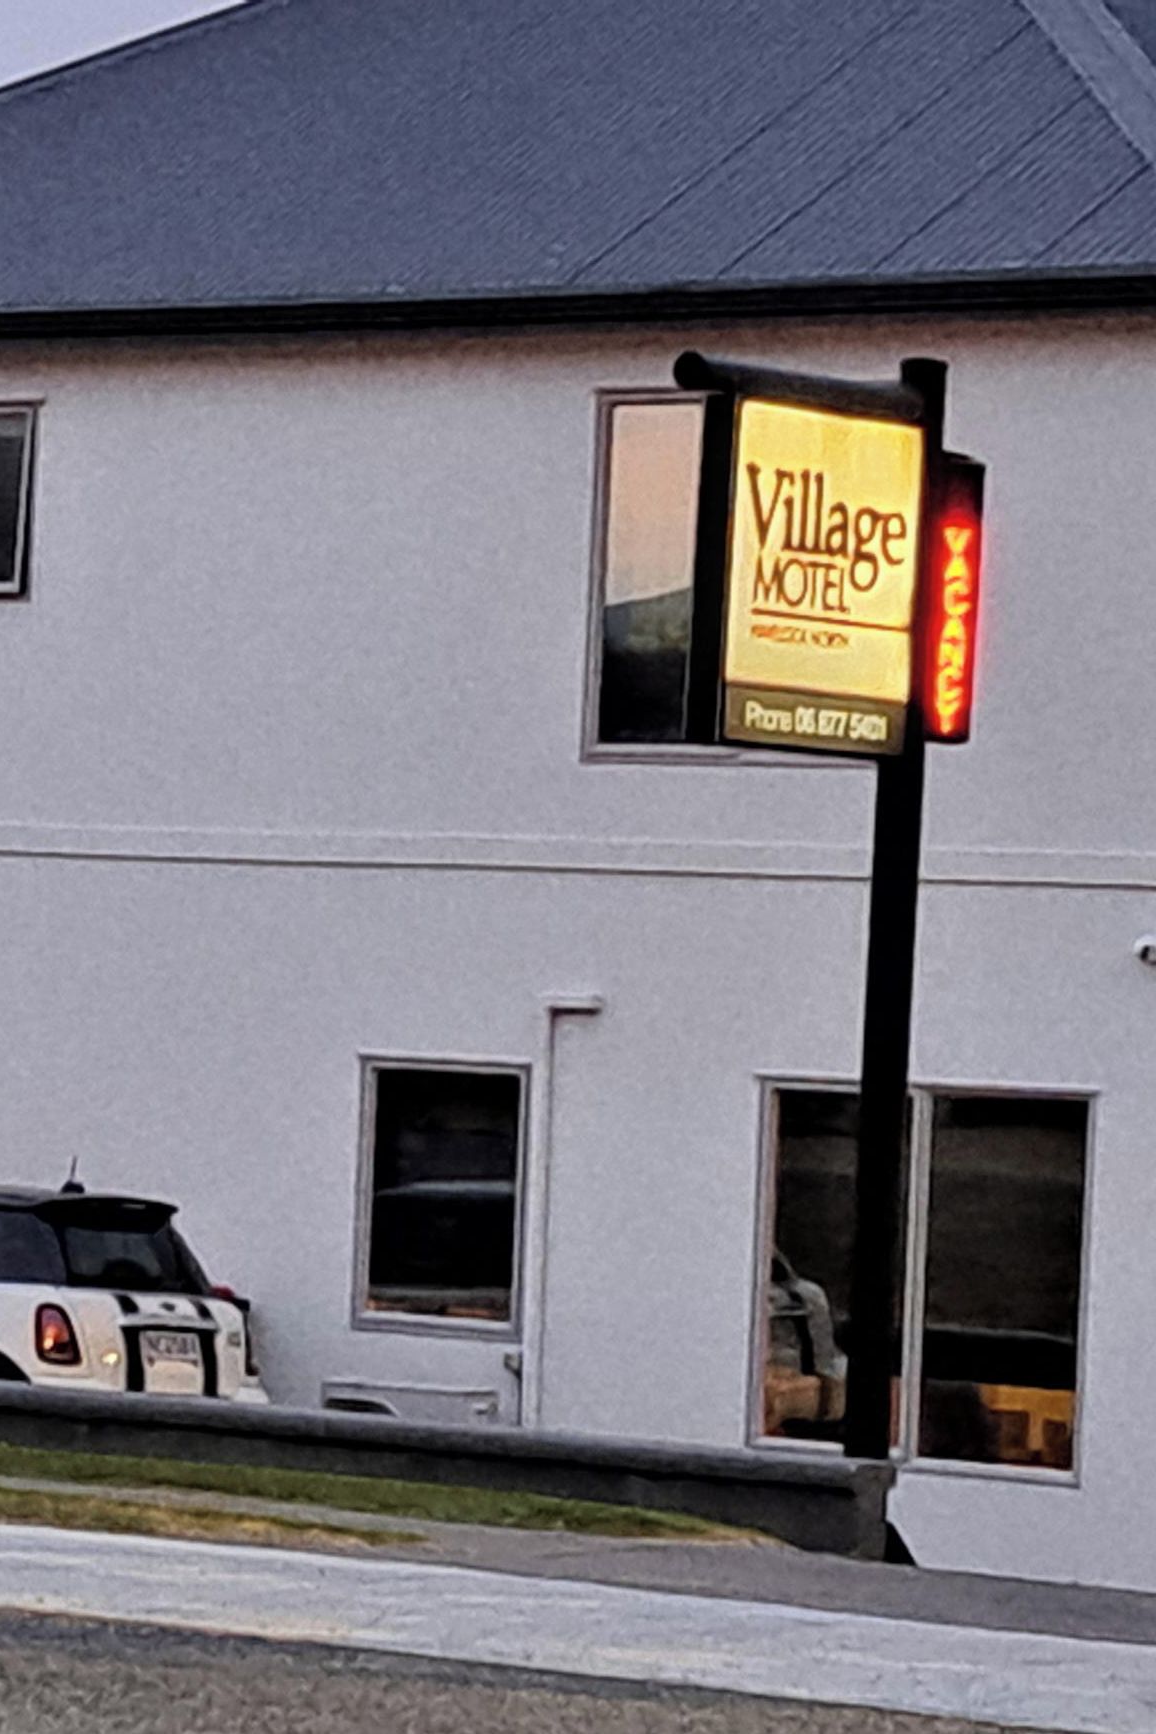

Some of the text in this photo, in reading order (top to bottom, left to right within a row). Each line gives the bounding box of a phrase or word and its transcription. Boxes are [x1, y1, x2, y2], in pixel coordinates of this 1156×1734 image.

[745, 462, 908, 592] Village
[752, 555, 850, 614] MOTEL
[935, 526, 973, 734] VACANCY
[745, 700, 793, 732] Phone
